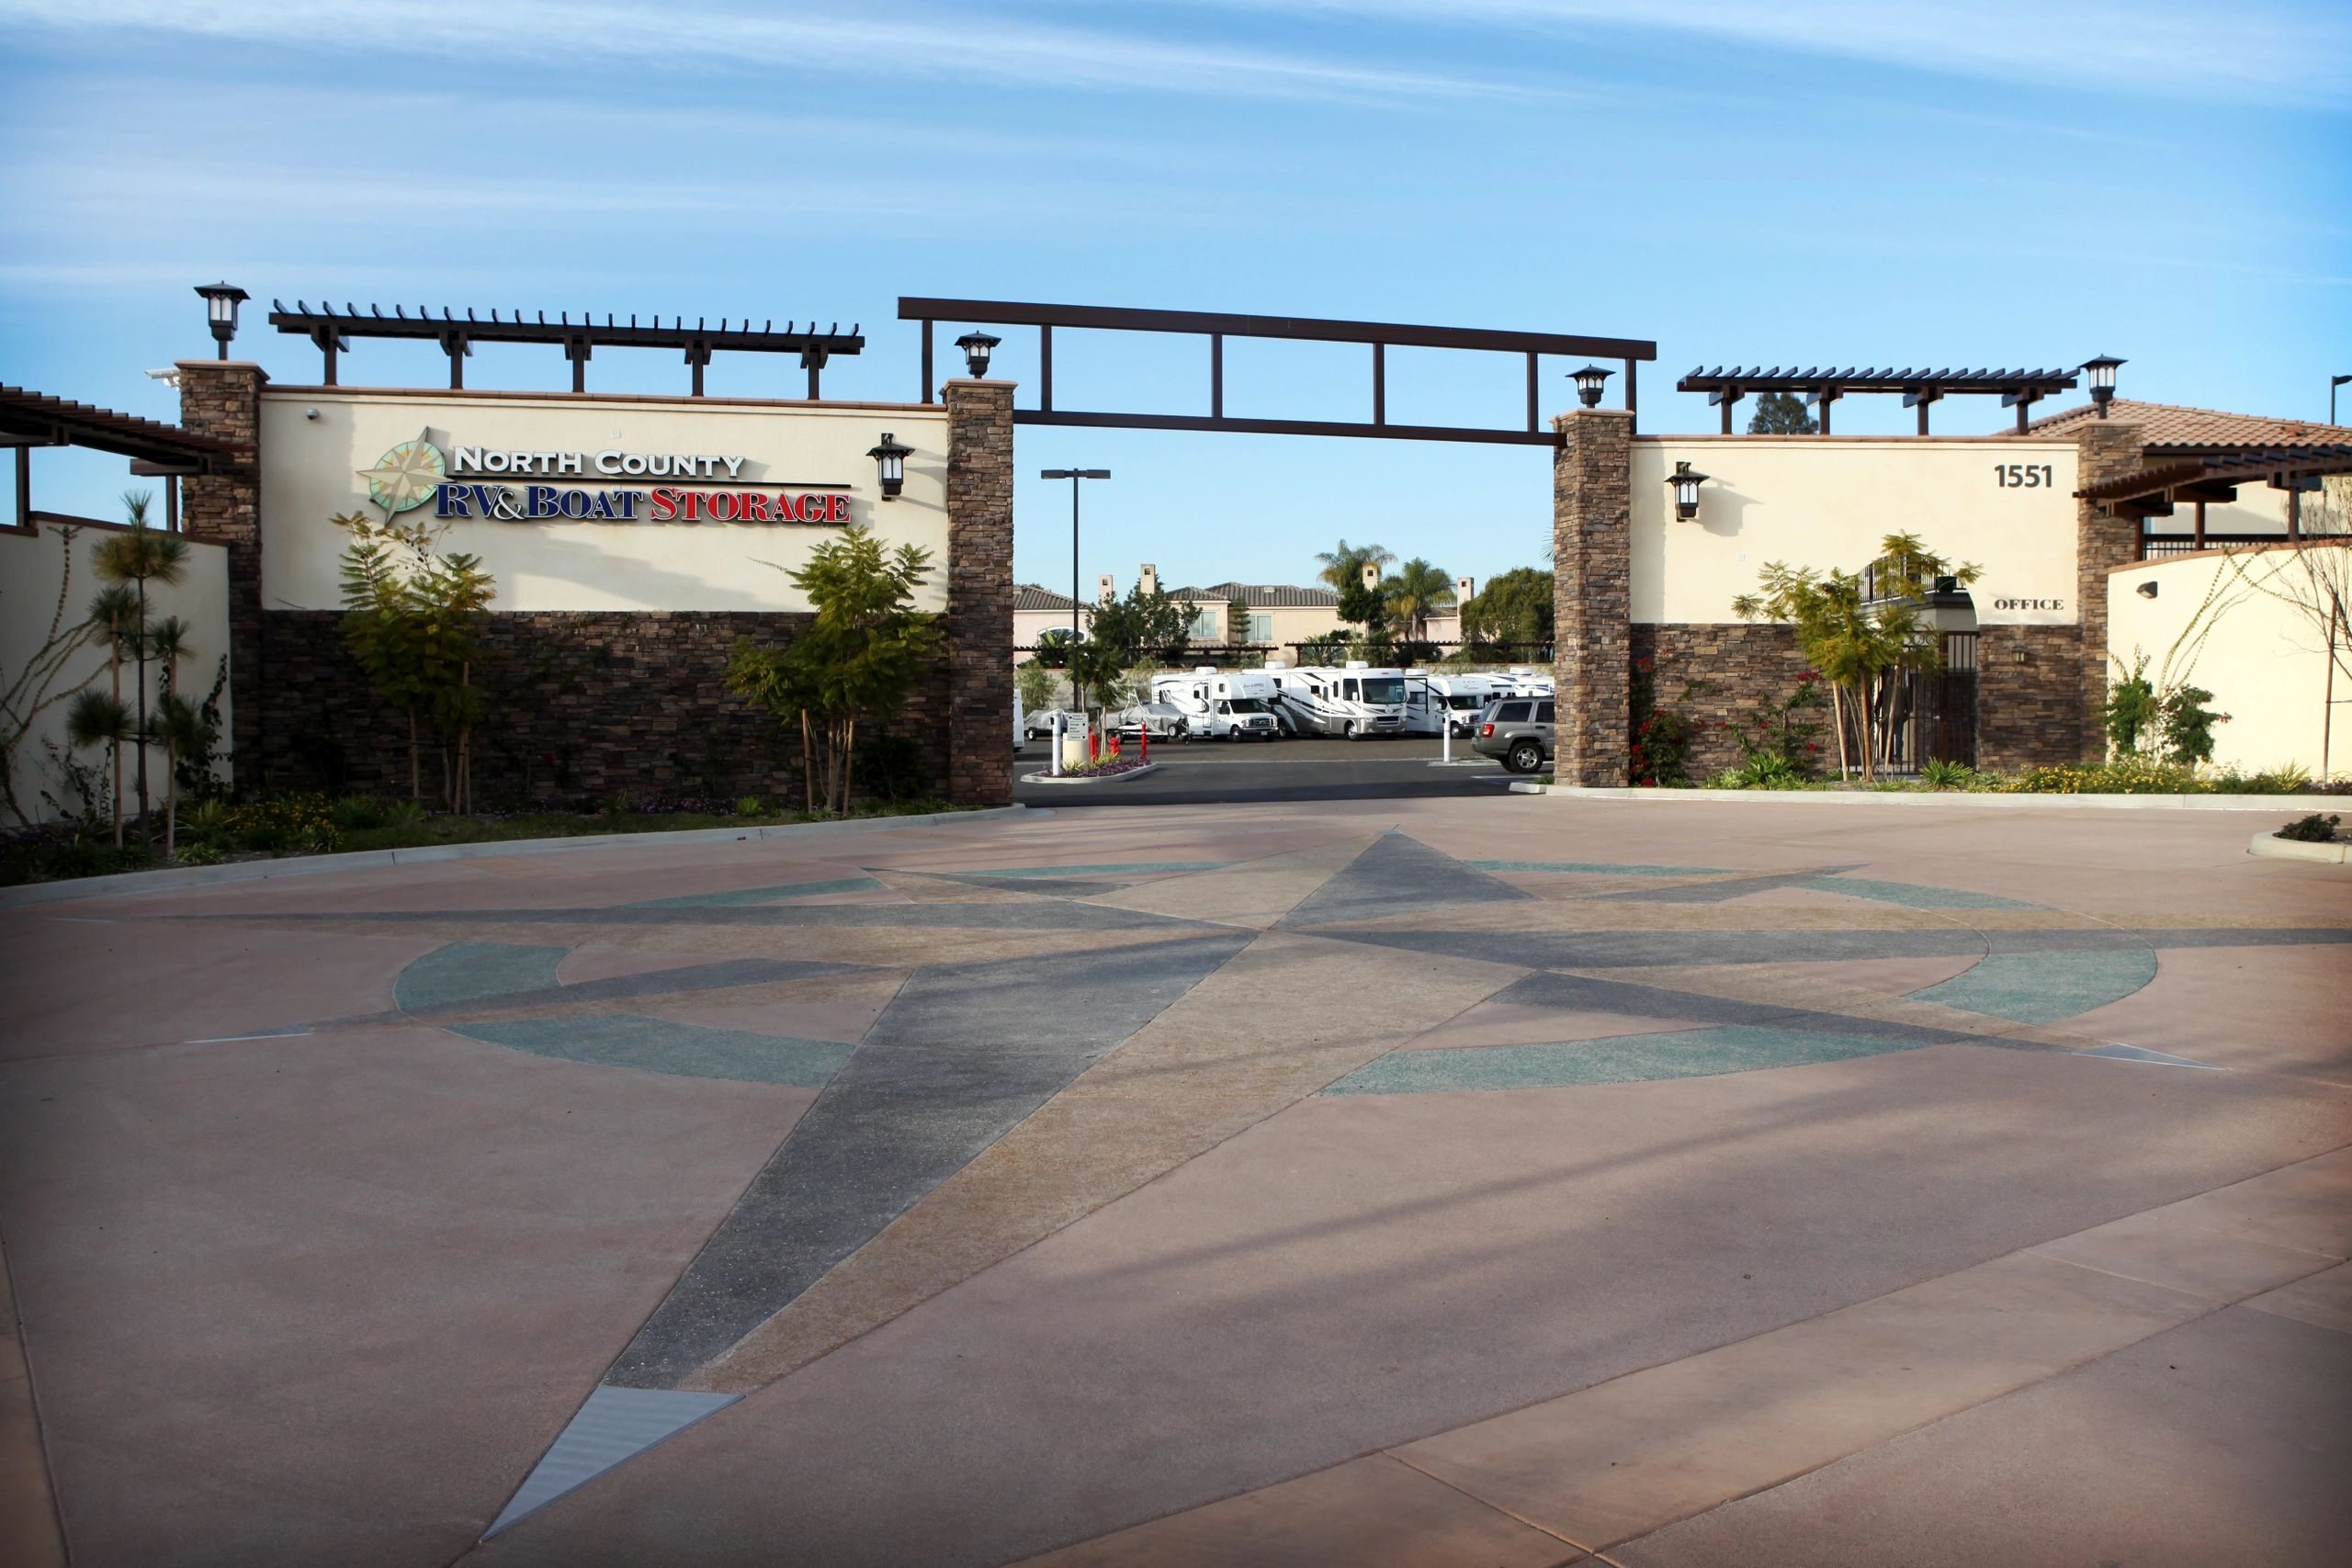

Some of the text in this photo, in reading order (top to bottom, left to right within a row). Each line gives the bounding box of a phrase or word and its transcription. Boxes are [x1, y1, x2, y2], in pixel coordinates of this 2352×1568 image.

[454, 446, 745, 478] NORTH COUNTY
[1994, 464, 2052, 488] 1551
[650, 486, 852, 523] STORAGE
[1994, 599, 2064, 611] OFFICE
